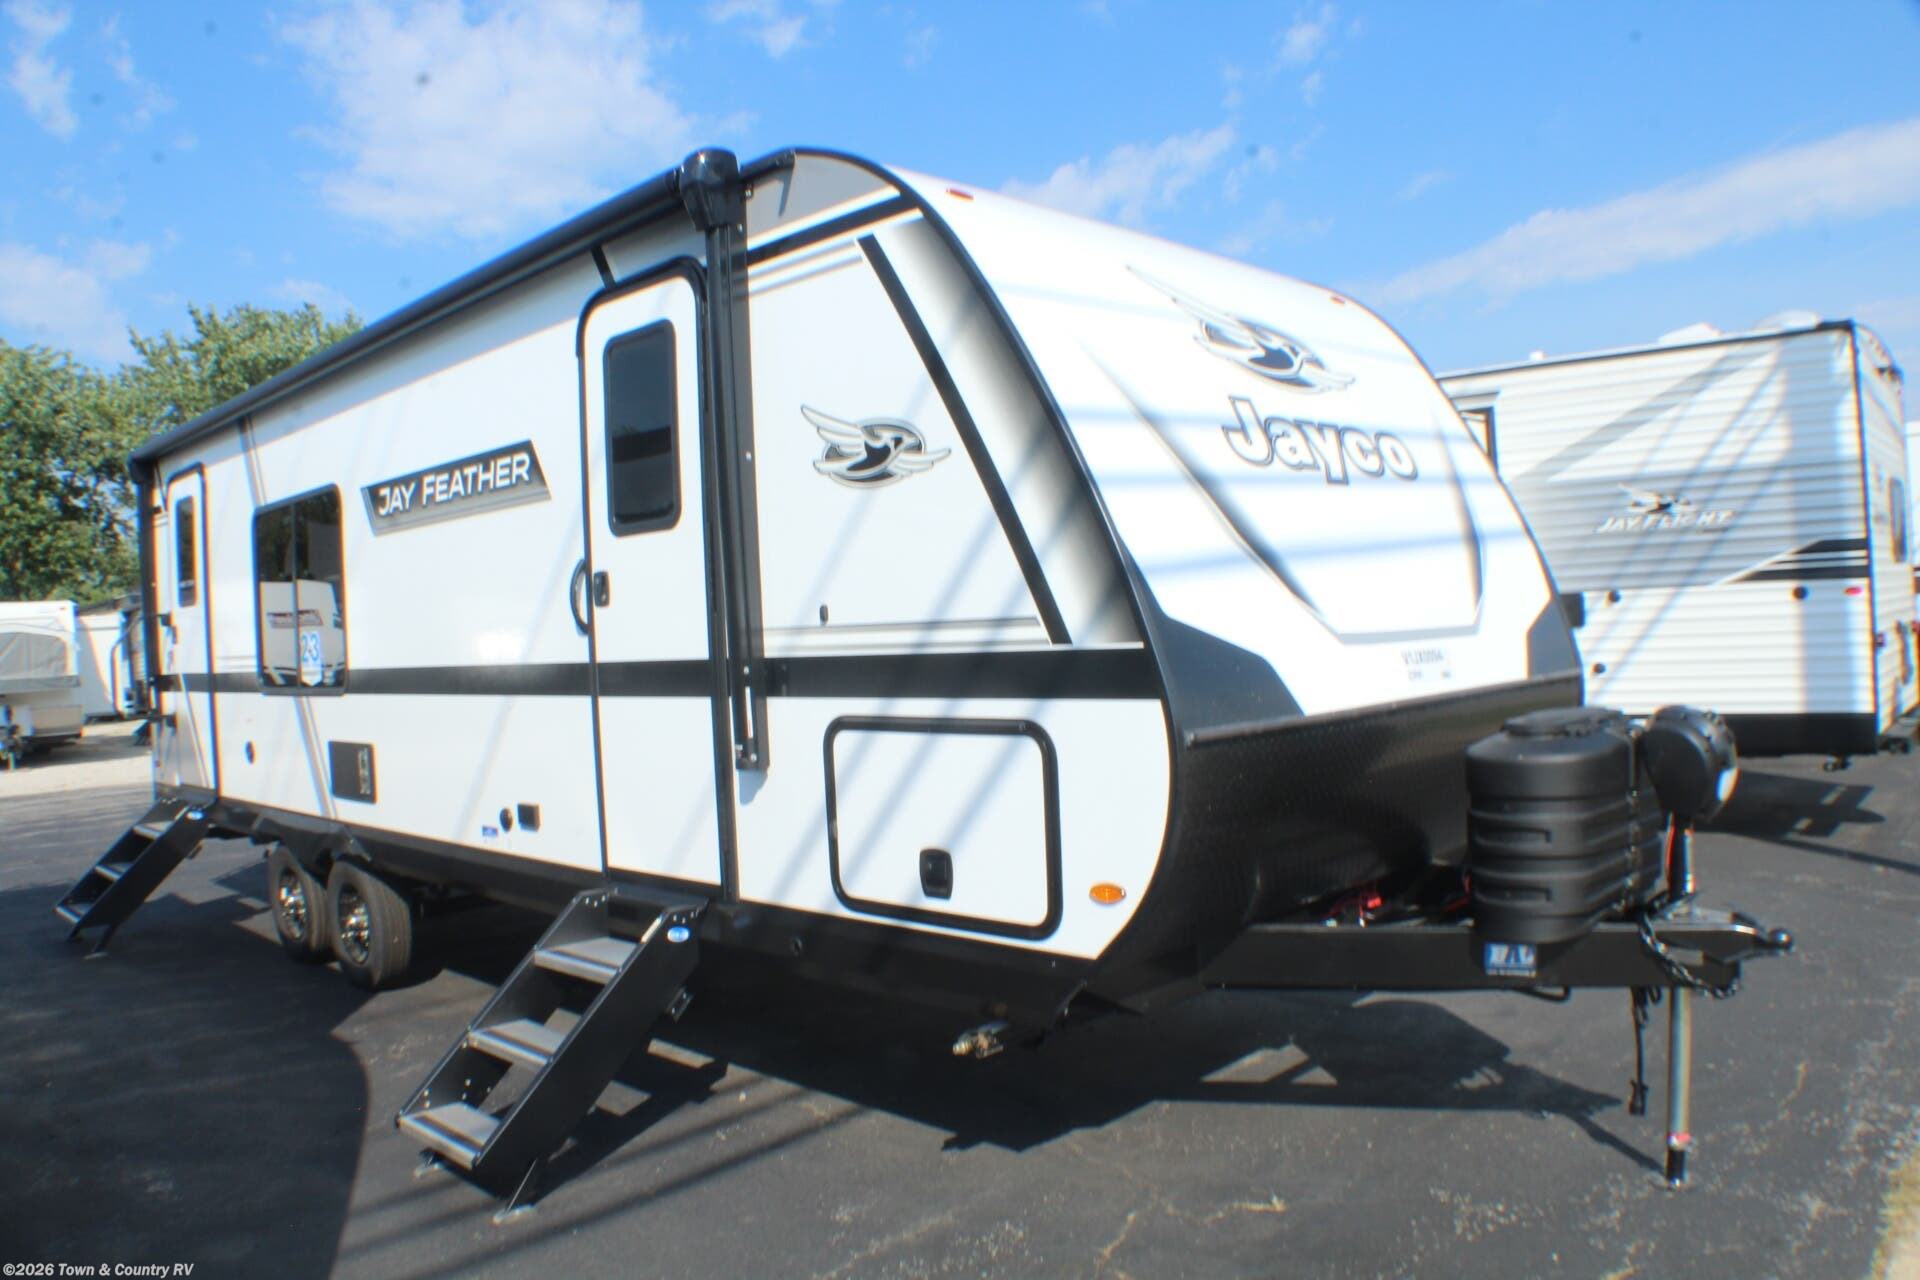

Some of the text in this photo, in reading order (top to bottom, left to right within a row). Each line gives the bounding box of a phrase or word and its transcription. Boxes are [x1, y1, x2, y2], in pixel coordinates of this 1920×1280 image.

[1221, 395, 1418, 485] Jayco
[377, 451, 531, 516] JAY FEATHER
